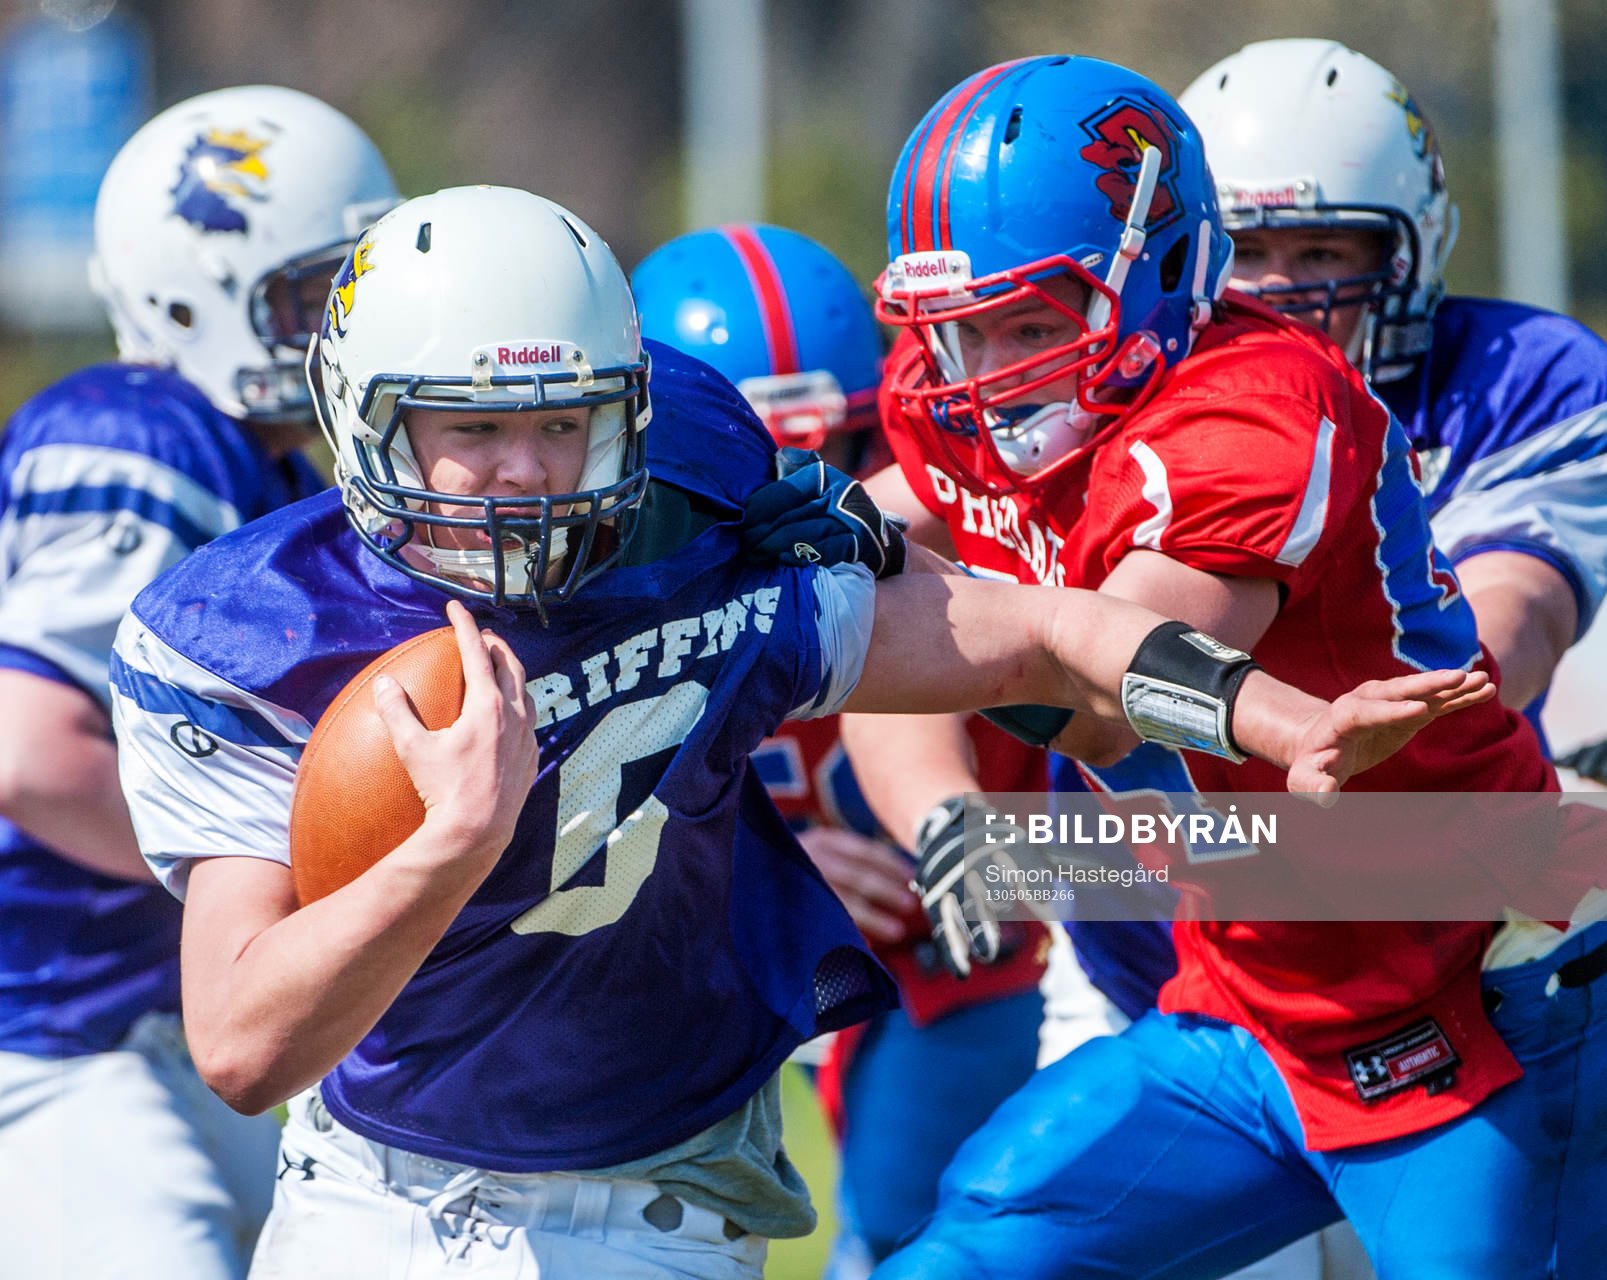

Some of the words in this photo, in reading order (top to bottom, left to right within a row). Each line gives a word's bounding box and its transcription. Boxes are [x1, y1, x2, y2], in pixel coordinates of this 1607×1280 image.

[904, 258, 947, 277] Riddell
[497, 345, 561, 365] Riddell
[525, 586, 782, 731] RIFFINS
